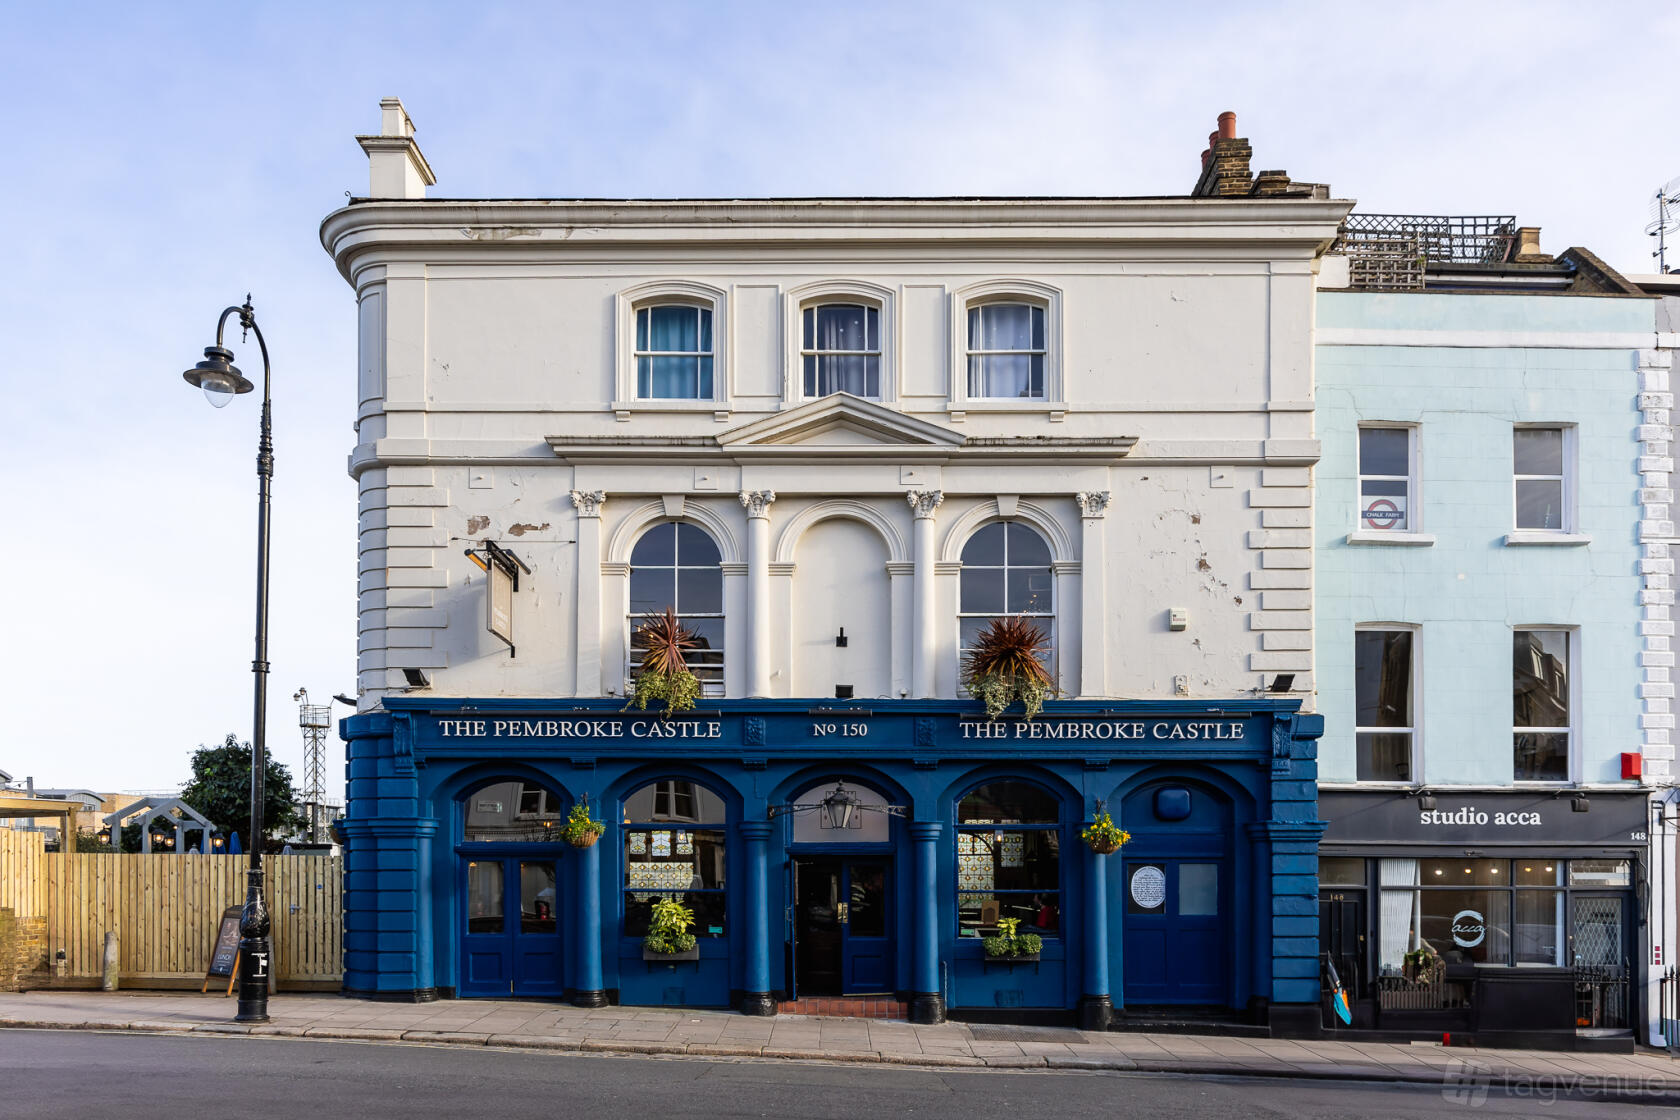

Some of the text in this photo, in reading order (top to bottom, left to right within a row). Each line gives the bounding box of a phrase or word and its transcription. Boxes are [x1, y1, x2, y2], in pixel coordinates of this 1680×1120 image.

[439, 720, 721, 738] THE PEMBROKE CASTLE
[843, 723, 868, 737] 150
[959, 722, 1244, 739] THE PEMBROKE CASTLE
[1420, 807, 1541, 825] studio acca
[1630, 832, 1646, 840] 148
